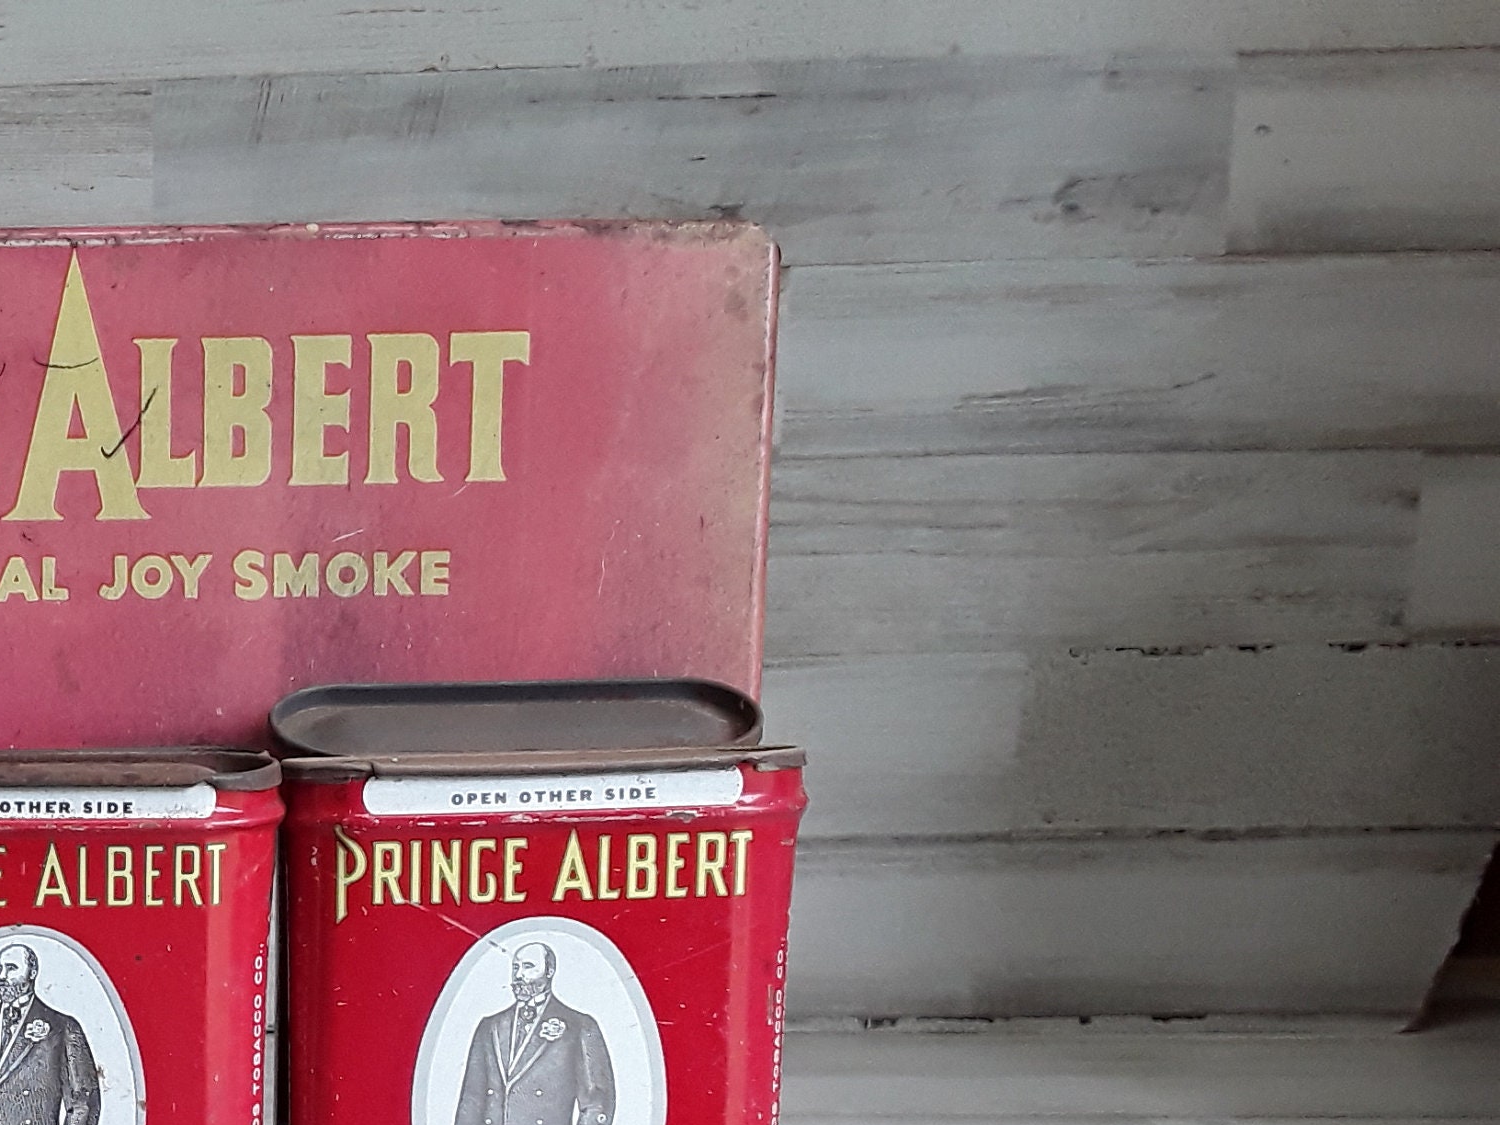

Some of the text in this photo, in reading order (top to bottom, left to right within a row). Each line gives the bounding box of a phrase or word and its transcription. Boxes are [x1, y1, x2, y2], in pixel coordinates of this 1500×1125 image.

[1, 249, 530, 523] ALBERT
[99, 554, 213, 601] JOY
[233, 549, 451, 598] SMOKE
[0, 801, 71, 813] OTHER
[83, 802, 133, 814] SIDE
[450, 787, 657, 806] OPEN OTHER SIDE
[33, 842, 227, 907] ALBERT
[333, 823, 753, 924] PRINCE ALBERT
[252, 994, 263, 1095] TOBACCO
[772, 989, 783, 1093] TOBACCO
